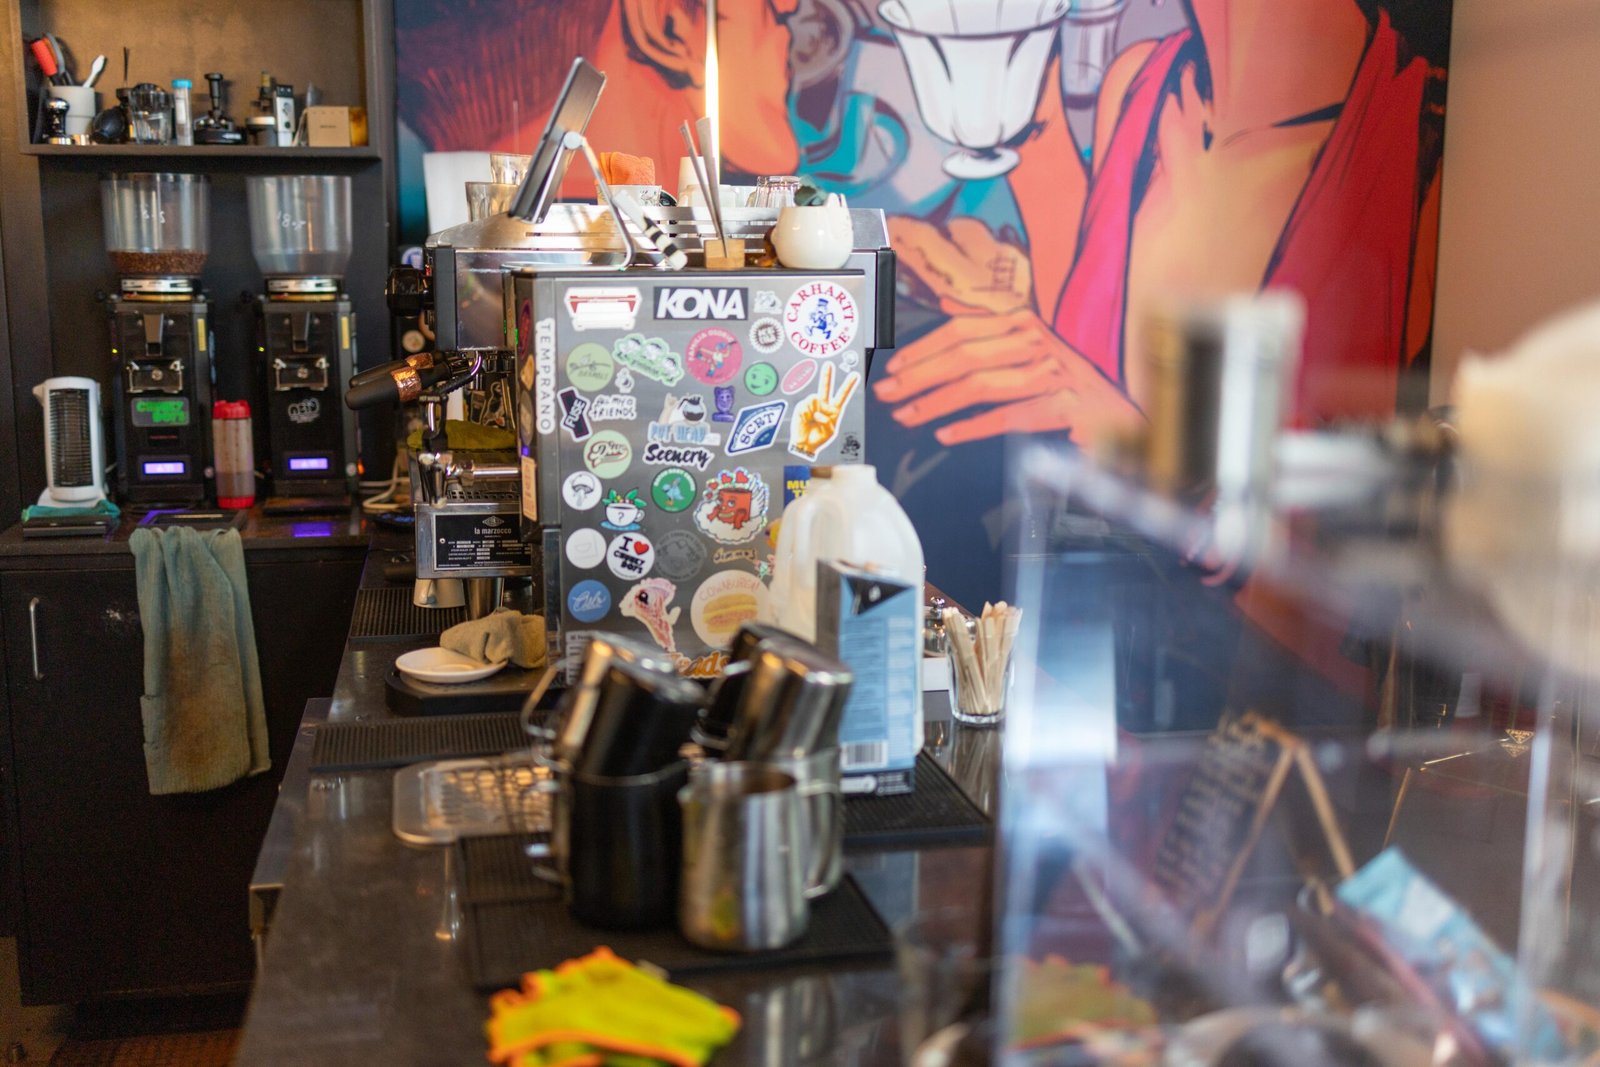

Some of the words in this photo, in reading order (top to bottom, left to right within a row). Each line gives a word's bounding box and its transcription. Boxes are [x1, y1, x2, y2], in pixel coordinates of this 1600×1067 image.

[657, 289, 745, 319] KONA
[788, 283, 854, 322] CARHARTT
[791, 331, 850, 354] COFFEE
[540, 324, 551, 430] TEMPRANO
[566, 399, 585, 428] FUSE
[645, 443, 709, 468] Scenery
[481, 527, 512, 535] marzocco
[619, 536, 633, 552] I
